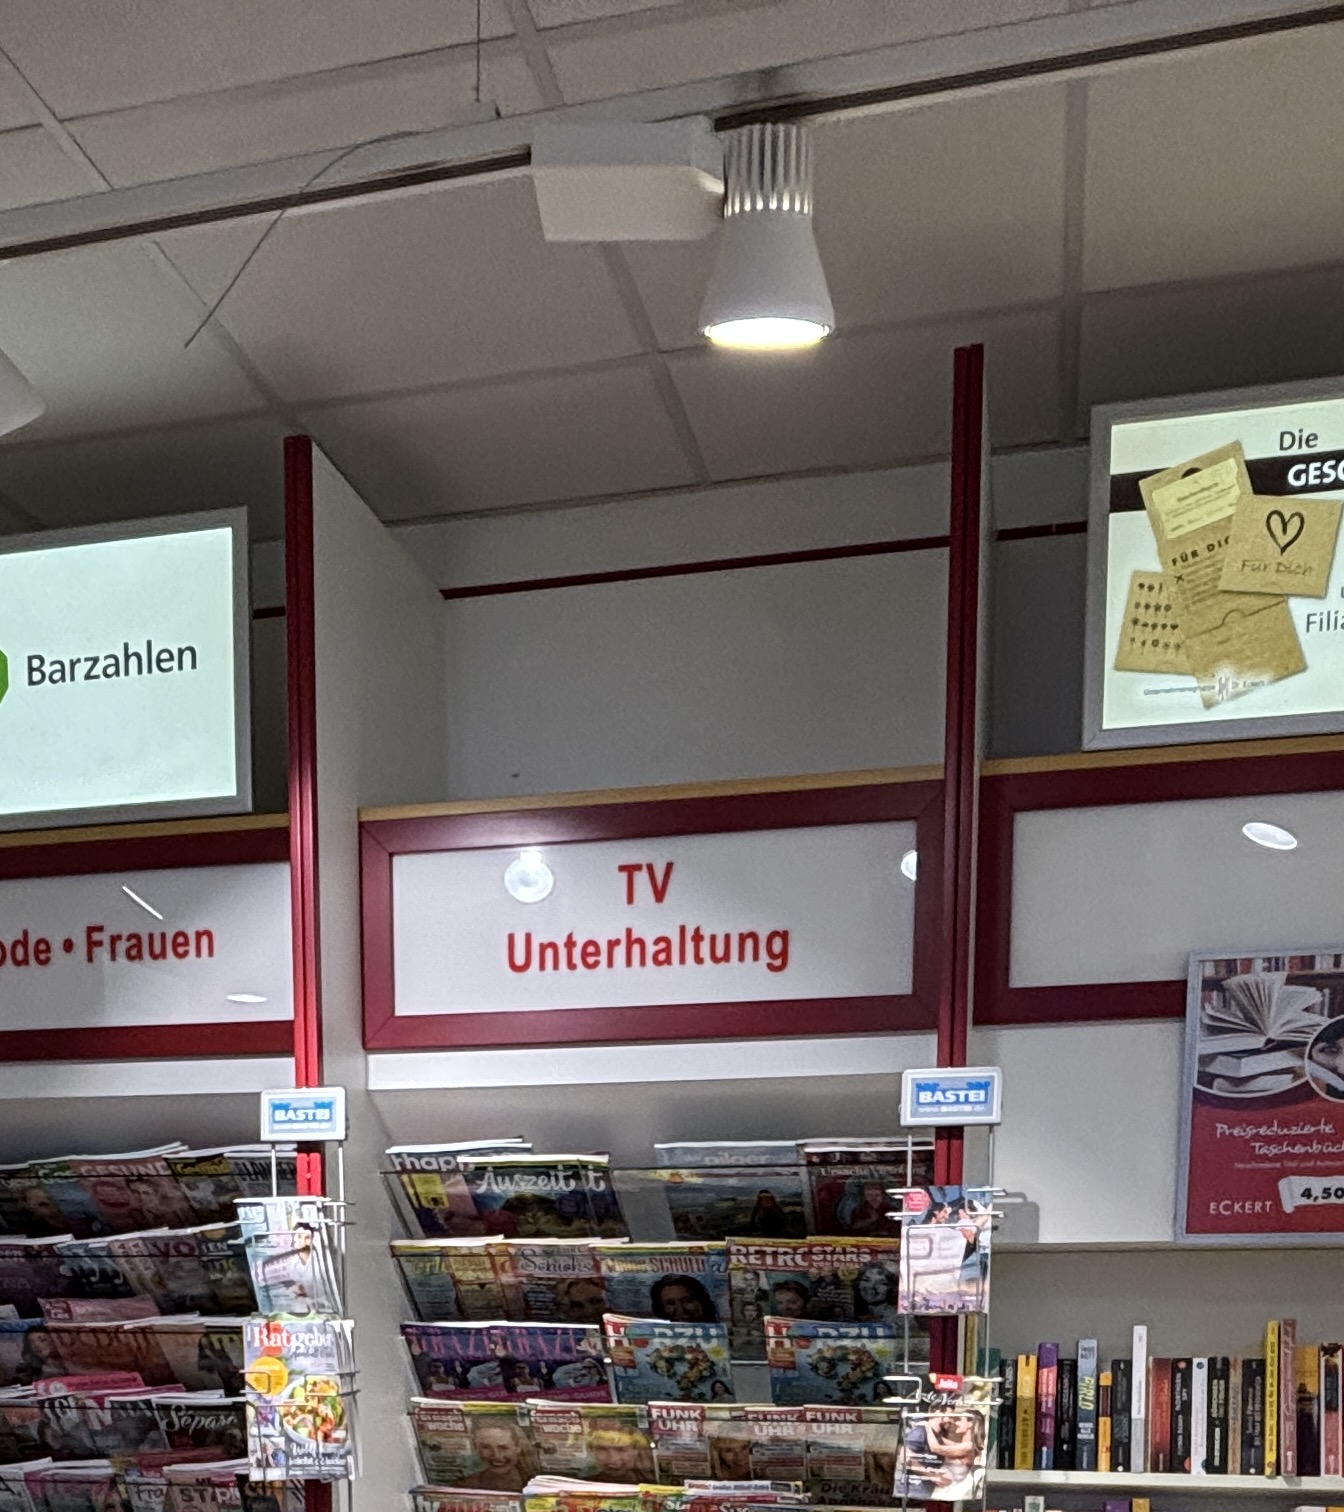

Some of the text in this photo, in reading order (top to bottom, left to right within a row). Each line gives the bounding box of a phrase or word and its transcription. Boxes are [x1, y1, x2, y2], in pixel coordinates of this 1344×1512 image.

[1278, 429, 1319, 451] Die
[26, 639, 199, 690] Barzahlen
[617, 860, 675, 906] TV
[84, 923, 216, 963] Frauen
[506, 923, 791, 975] Unterhaltung
[918, 1090, 986, 1104] BASTEI
[274, 1109, 330, 1121] BASTEI
[1216, 1120, 1335, 1140] Preisreduzierte
[1209, 1200, 1273, 1216] ECKERT
